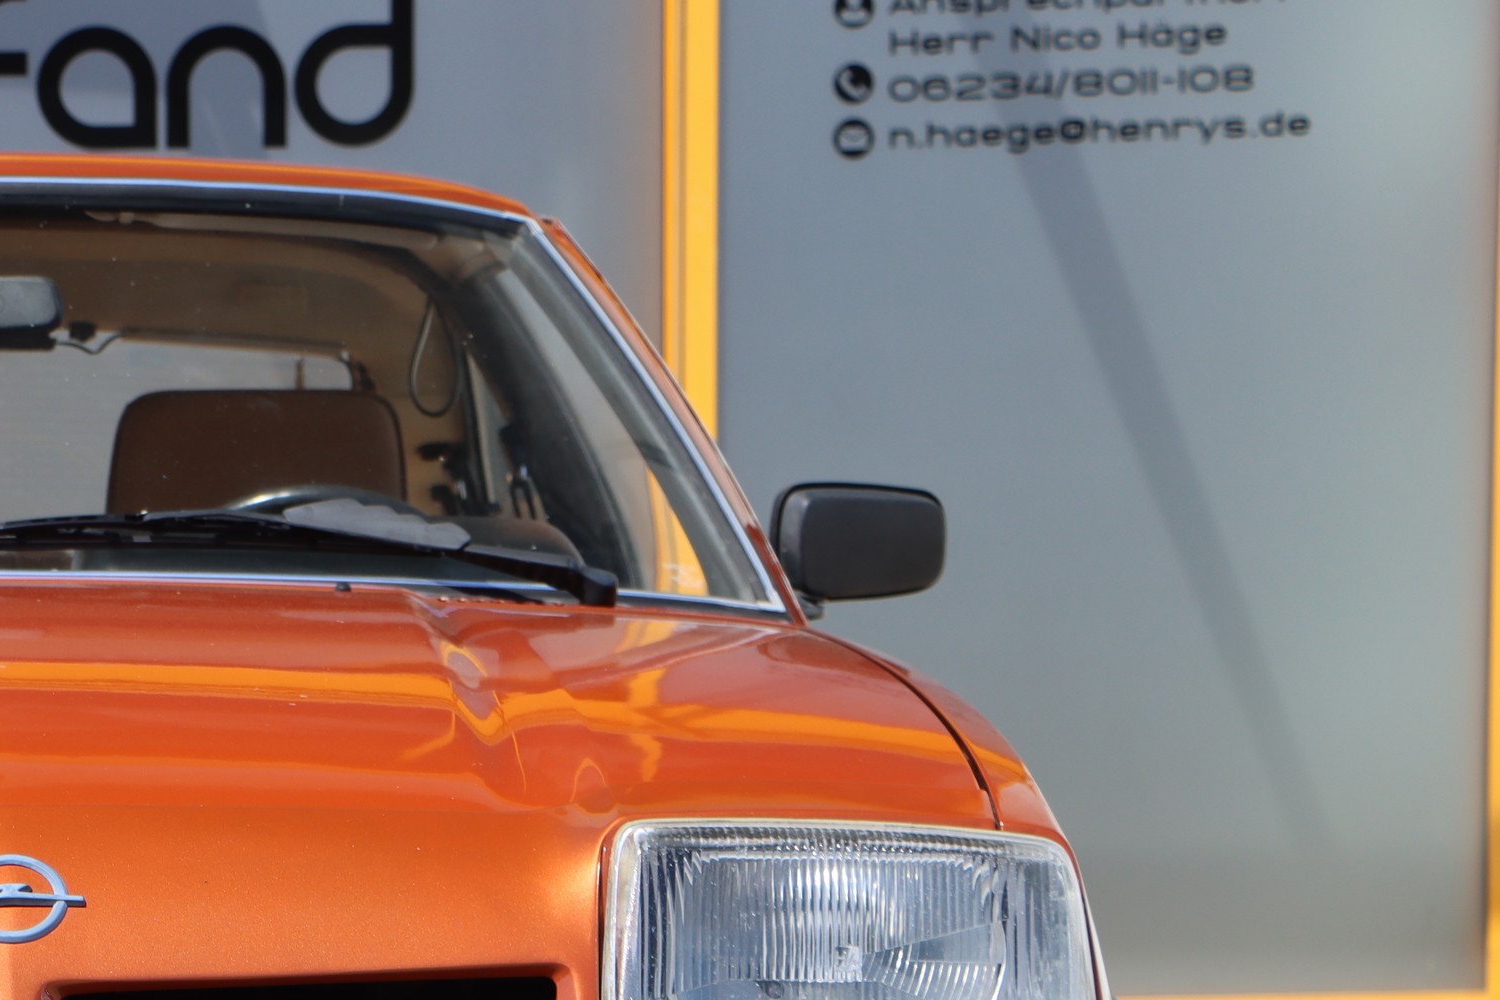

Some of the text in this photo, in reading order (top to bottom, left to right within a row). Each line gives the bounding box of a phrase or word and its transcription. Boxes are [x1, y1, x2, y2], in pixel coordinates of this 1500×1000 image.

[889, 29, 994, 55] Herr
[1010, 25, 1101, 52] Nico
[888, 64, 1254, 103] 06234/8011-108
[889, 111, 1311, 154] n.haege@henrys.de
